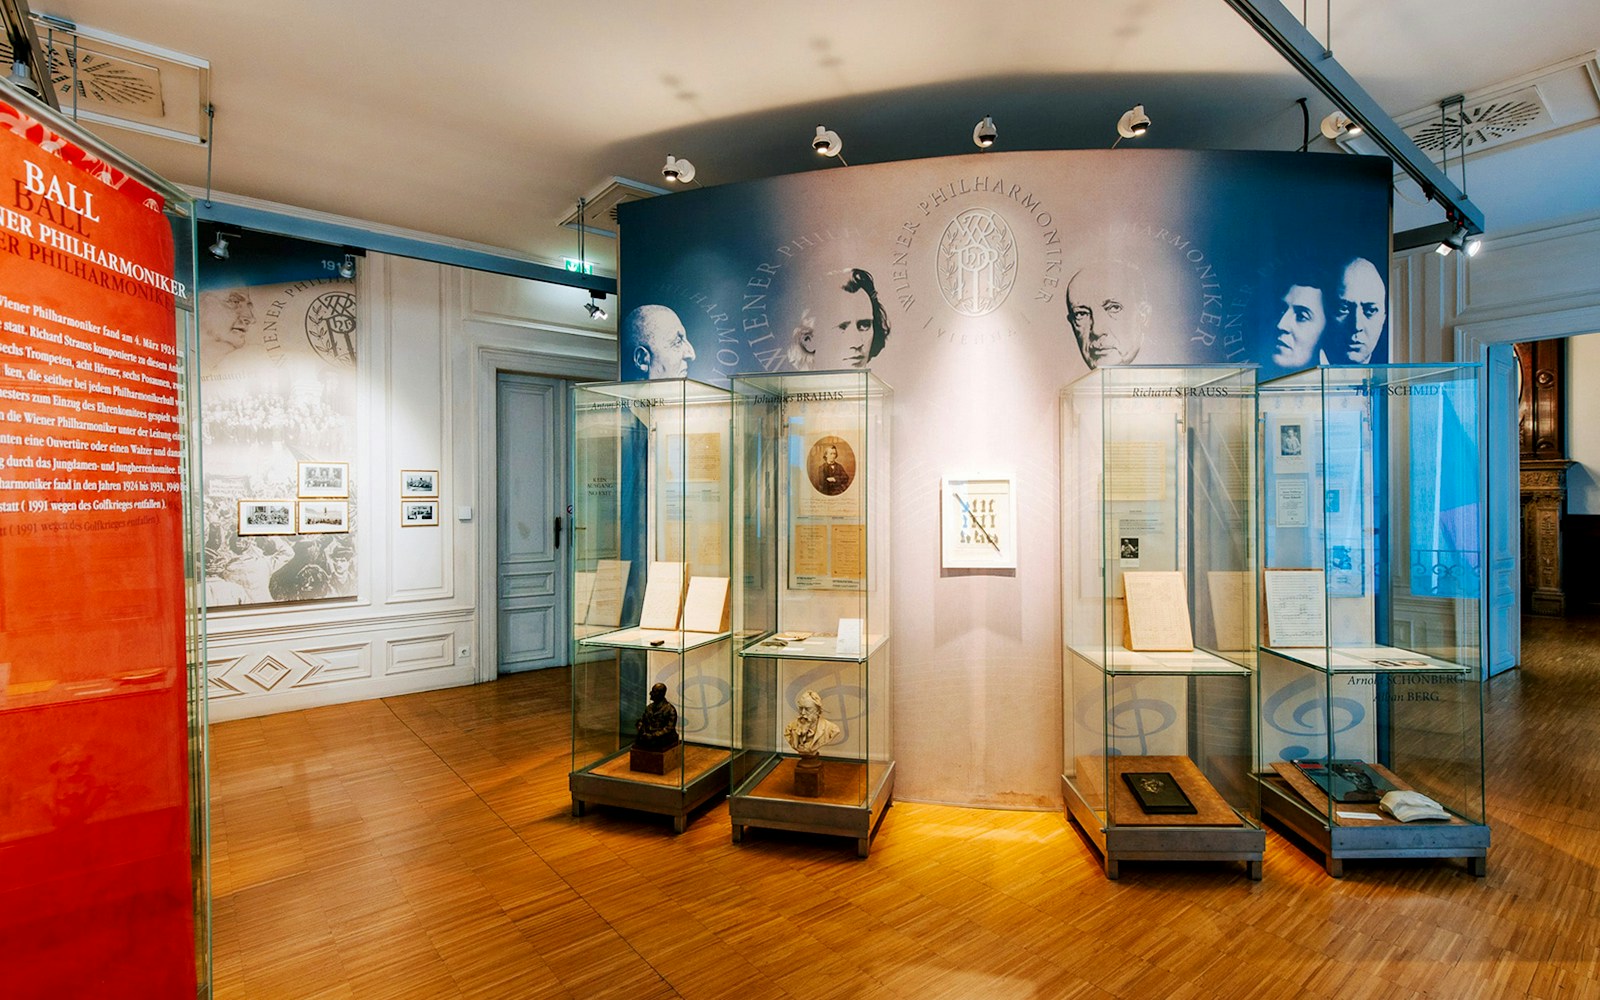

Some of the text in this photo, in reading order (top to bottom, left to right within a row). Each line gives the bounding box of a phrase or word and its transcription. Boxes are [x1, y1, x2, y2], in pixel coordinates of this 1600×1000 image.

[23, 159, 100, 223] BALL
[892, 176, 1062, 312] WIENER PHILHARMONIKER
[39, 223, 187, 299] PHILHARMONIKER
[33, 305, 101, 334] Philharmoniker
[102, 325, 120, 340] fand
[121, 333, 133, 344] am
[134, 335, 142, 346] 4.
[143, 338, 159, 351] März
[161, 344, 175, 356] 1924
[3, 321, 28, 336] statt.
[29, 325, 63, 344] Richard
[64, 335, 92, 351] Strauss
[93, 342, 137, 363] komponierte
[138, 355, 146, 365] zu
[146, 356, 168, 370] diesem
[25, 346, 74, 369] Trompeten,
[76, 359, 92, 372] acht
[94, 362, 121, 379] Hörner,
[122, 370, 140, 382] sechs
[27, 368, 42, 382] die
[43, 374, 73, 388] seither
[74, 377, 87, 390] bei
[88, 381, 111, 395] jedem
[113, 385, 174, 406] Philharmonikerball
[796, 391, 844, 402] BRAHMS
[1132, 386, 1228, 398] Richard STRAUSS
[32, 393, 51, 404] zum
[53, 395, 81, 412] Einzug
[82, 399, 96, 411] des
[97, 402, 147, 419] Ehrenkomitees
[7, 409, 22, 423] die
[24, 412, 56, 426] Wiener
[57, 416, 117, 434] Philharmoniker
[118, 426, 136, 437] unter
[137, 426, 149, 437] der
[149, 428, 172, 442] Leitung
[24, 433, 45, 446] eine
[46, 436, 89, 450] Ouvertüre
[90, 440, 108, 452] oder
[109, 443, 129, 454] einen
[130, 444, 153, 456] Walzer
[153, 446, 166, 457] und
[6, 454, 34, 468] durch
[36, 456, 51, 469] das
[52, 458, 100, 473] Jungdamen-
[101, 461, 115, 472] und
[53, 478, 72, 490] fand
[73, 480, 81, 490] in
[83, 479, 97, 490] den
[97, 480, 121, 493] Jahren
[123, 481, 139, 492] 1924
[139, 481, 149, 491] bis
[28, 500, 48, 513] 1991
[50, 502, 77, 514] wegen
[78, 499, 92, 511] des
[92, 498, 133, 513] Golfkrieges
[133, 498, 161, 509] entfallen
[1407, 691, 1440, 702] BERG
